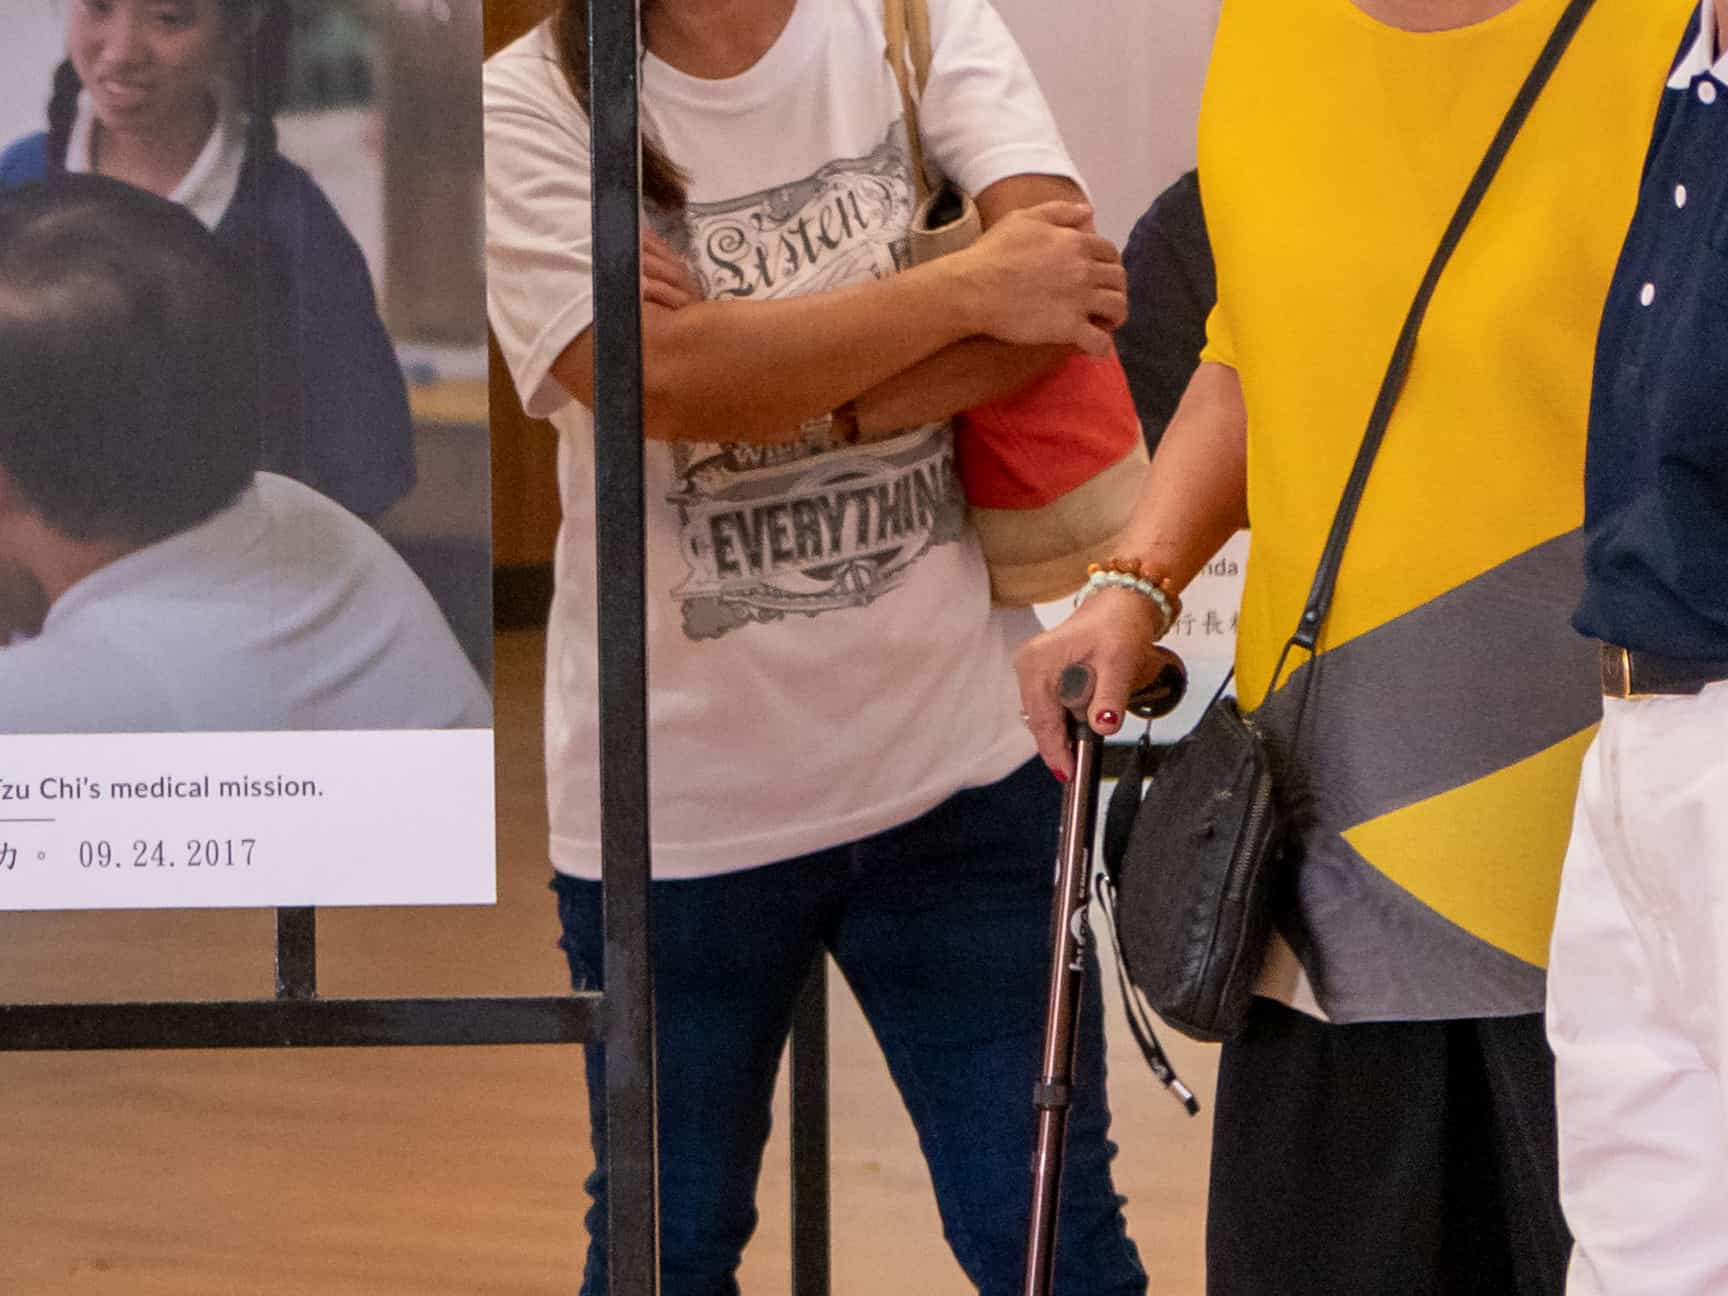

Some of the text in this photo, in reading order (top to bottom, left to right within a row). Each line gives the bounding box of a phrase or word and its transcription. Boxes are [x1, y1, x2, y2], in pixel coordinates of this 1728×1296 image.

[709, 458, 950, 579] EVERYTHIN
[40, 776, 102, 800] Chi's
[110, 776, 210, 800] medical
[219, 775, 325, 798] mission.
[78, 837, 257, 870] 09.24.2017
